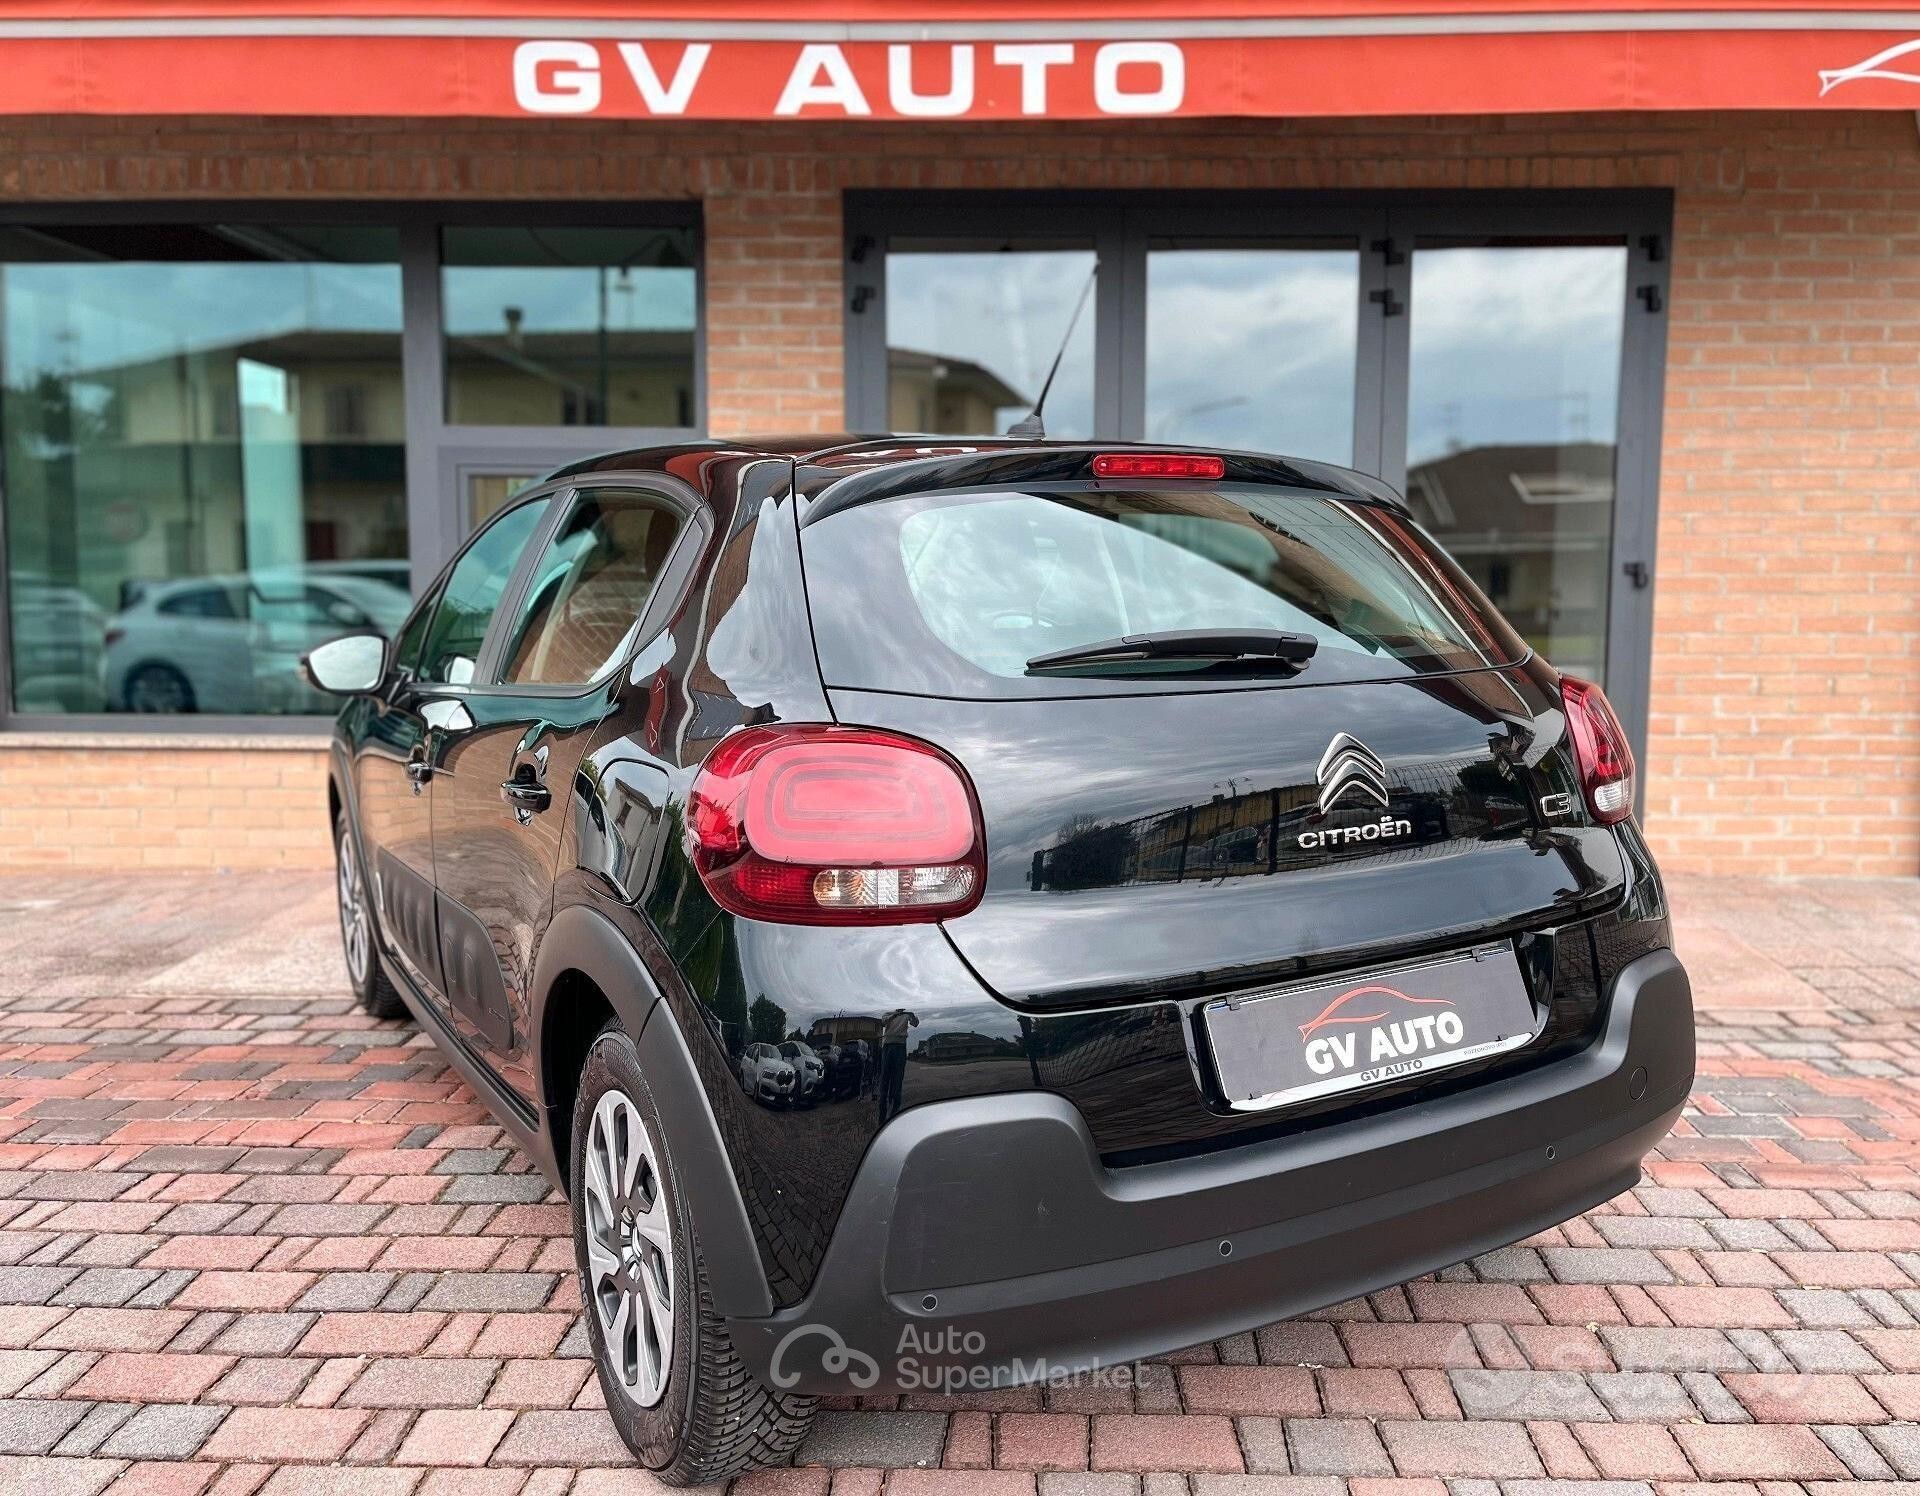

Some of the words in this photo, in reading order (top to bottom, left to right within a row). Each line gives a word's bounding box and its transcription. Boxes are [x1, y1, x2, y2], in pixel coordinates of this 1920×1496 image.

[513, 40, 712, 115] GV
[773, 42, 1185, 116] AUTO
[1539, 793, 1572, 818] C3
[1305, 1033, 1356, 1075] GV
[1370, 1011, 1465, 1062] AUTO
[1360, 1067, 1385, 1083] GV
[1386, 1059, 1423, 1077] AUTO
